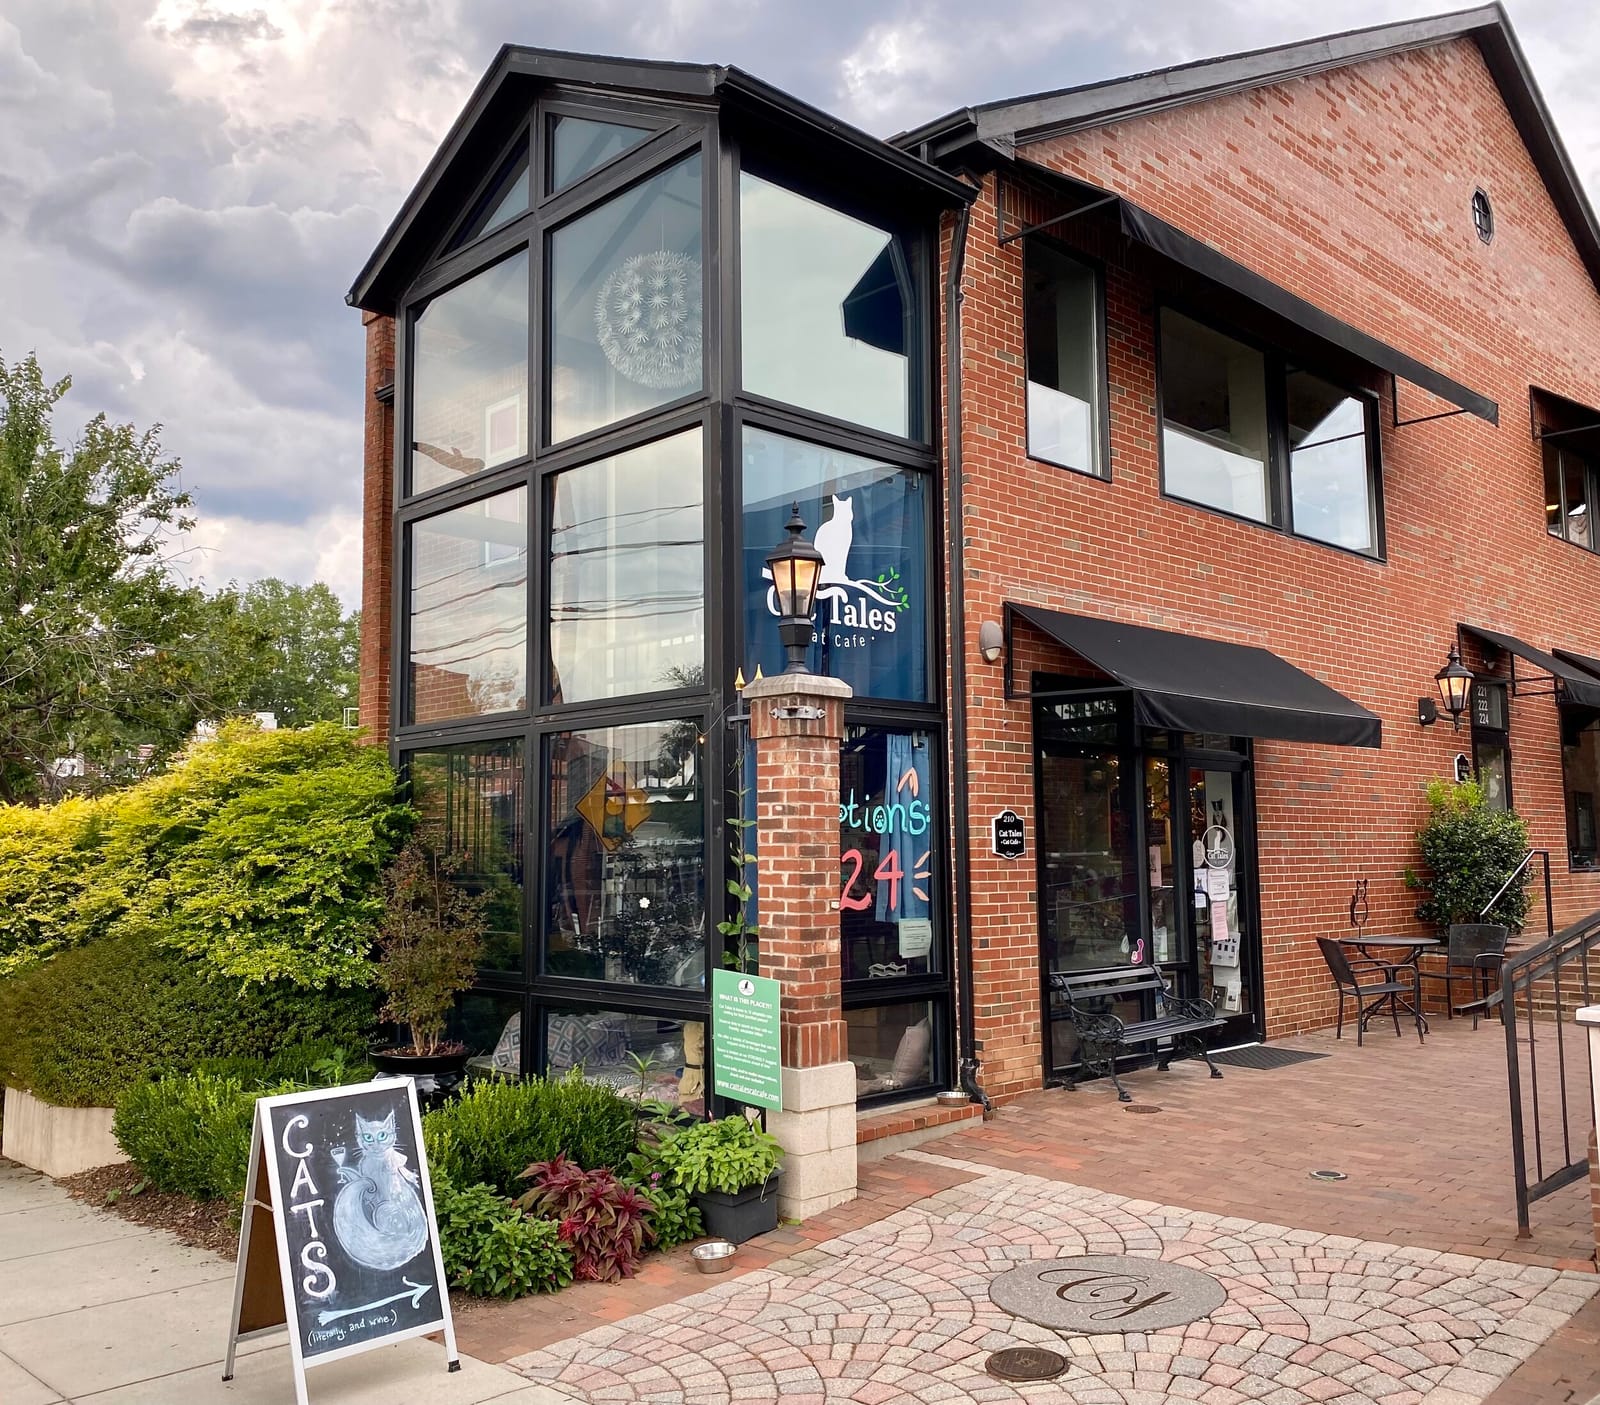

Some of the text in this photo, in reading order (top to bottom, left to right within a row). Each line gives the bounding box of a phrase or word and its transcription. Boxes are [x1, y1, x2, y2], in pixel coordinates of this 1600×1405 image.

[816, 586, 896, 633] Tales
[1478, 699, 1489, 711] 222
[1479, 712, 1489, 725] 224
[1003, 815, 1015, 823] 210
[998, 829, 1022, 837] Cat Tales
[349, 1317, 366, 1332] and
